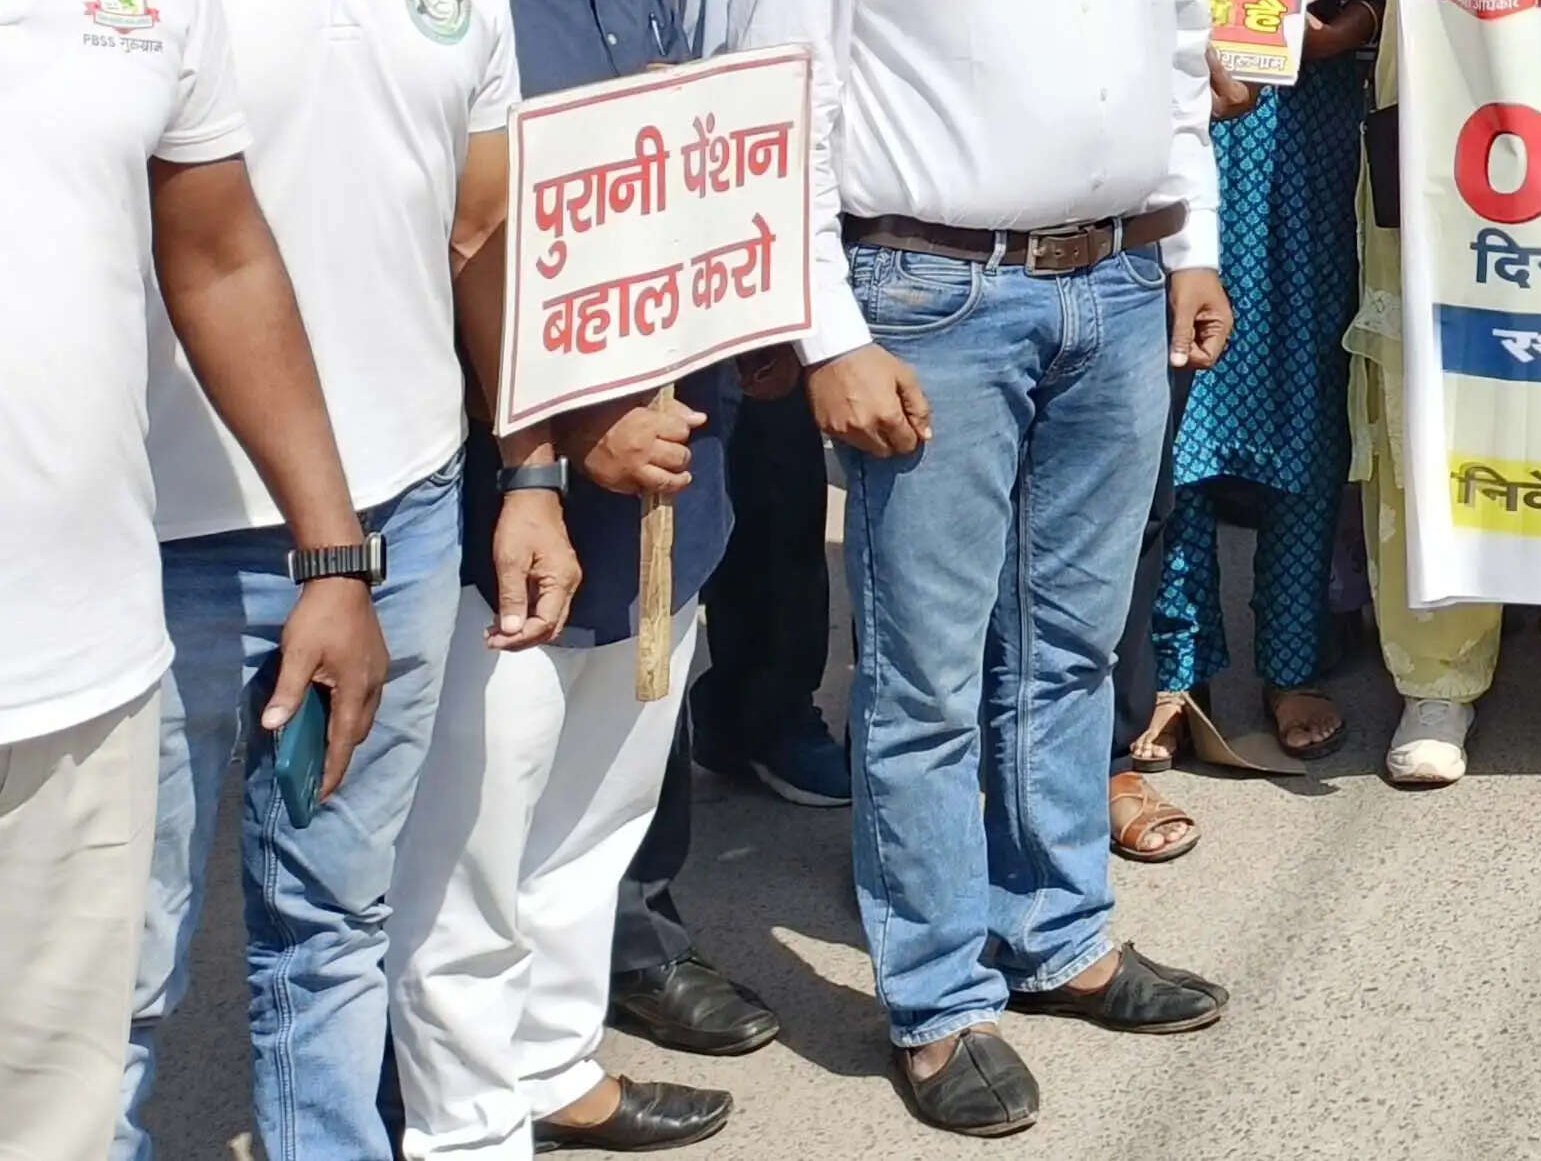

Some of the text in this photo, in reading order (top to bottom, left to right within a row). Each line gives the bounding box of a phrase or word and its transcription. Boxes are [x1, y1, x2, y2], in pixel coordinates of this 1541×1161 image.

[83, 33, 116, 48] PBSS
[533, 112, 794, 279] पुरानी पेंशन
[542, 212, 776, 355] बहाल करो
